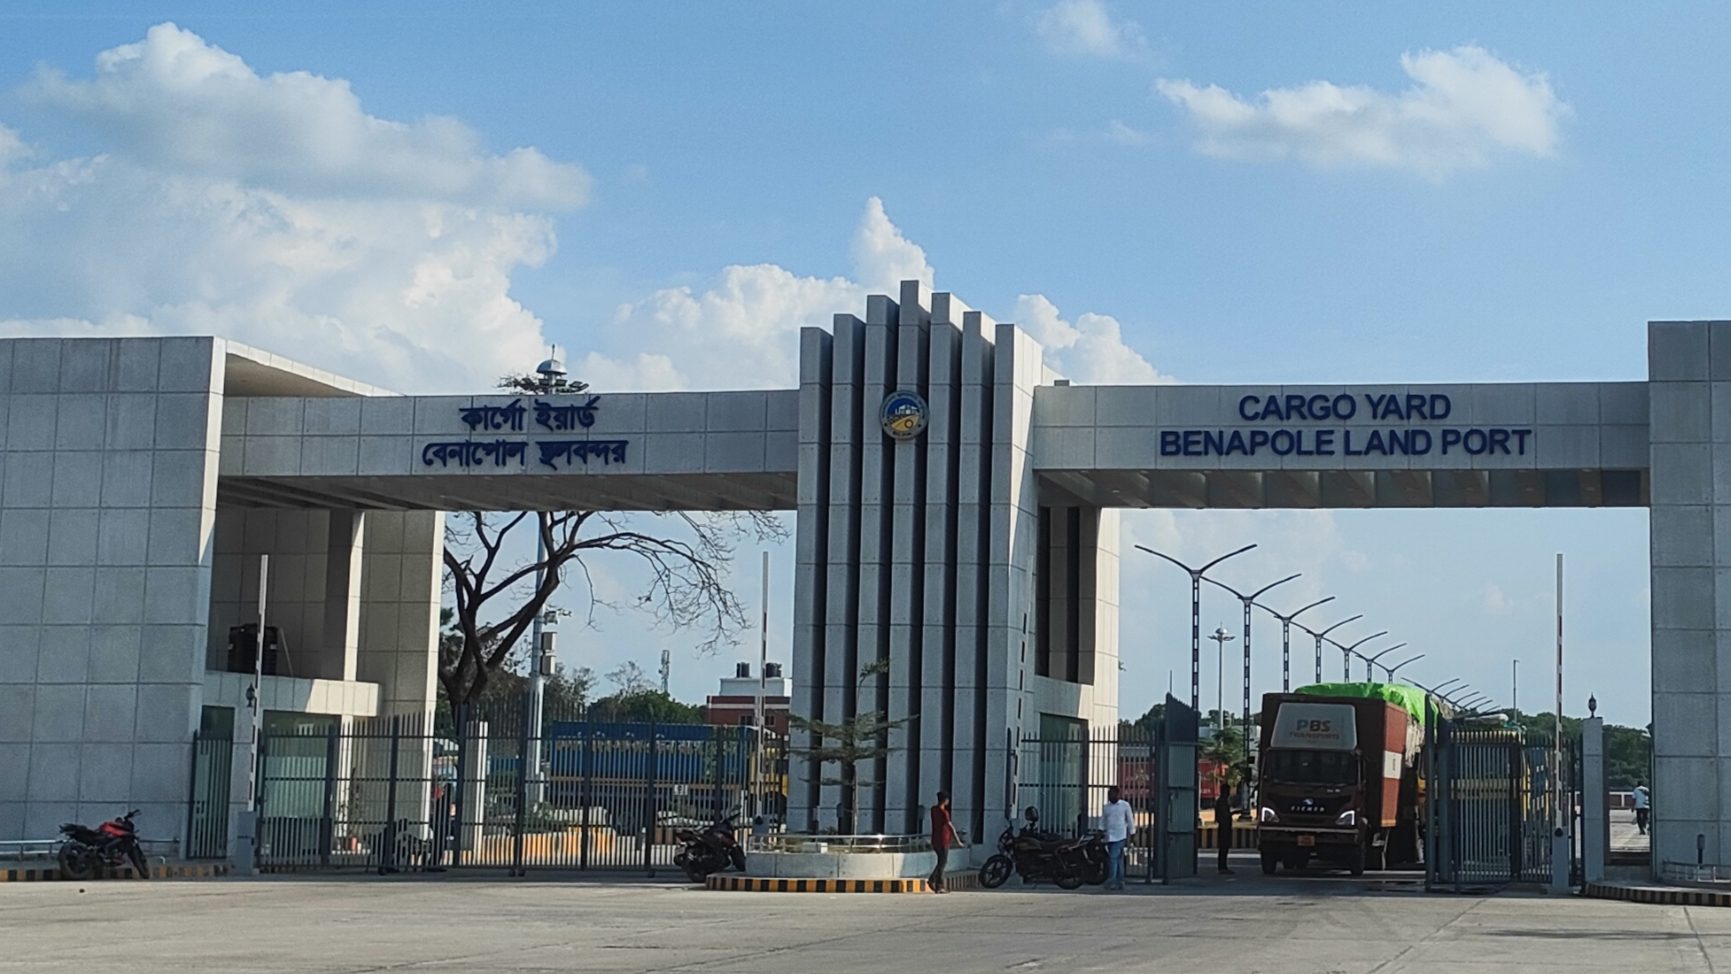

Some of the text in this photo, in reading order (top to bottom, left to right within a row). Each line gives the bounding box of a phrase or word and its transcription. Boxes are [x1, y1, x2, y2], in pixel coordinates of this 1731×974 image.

[459, 396, 601, 432] কার্গো ইয়ার্ড
[1239, 394, 1451, 421] CARGO YARD
[422, 439, 629, 471] বেনাপোল স্থলবন্দর
[1160, 429, 1532, 456] BENAPOLE LAND PORT
[1296, 719, 1331, 732] PBS
